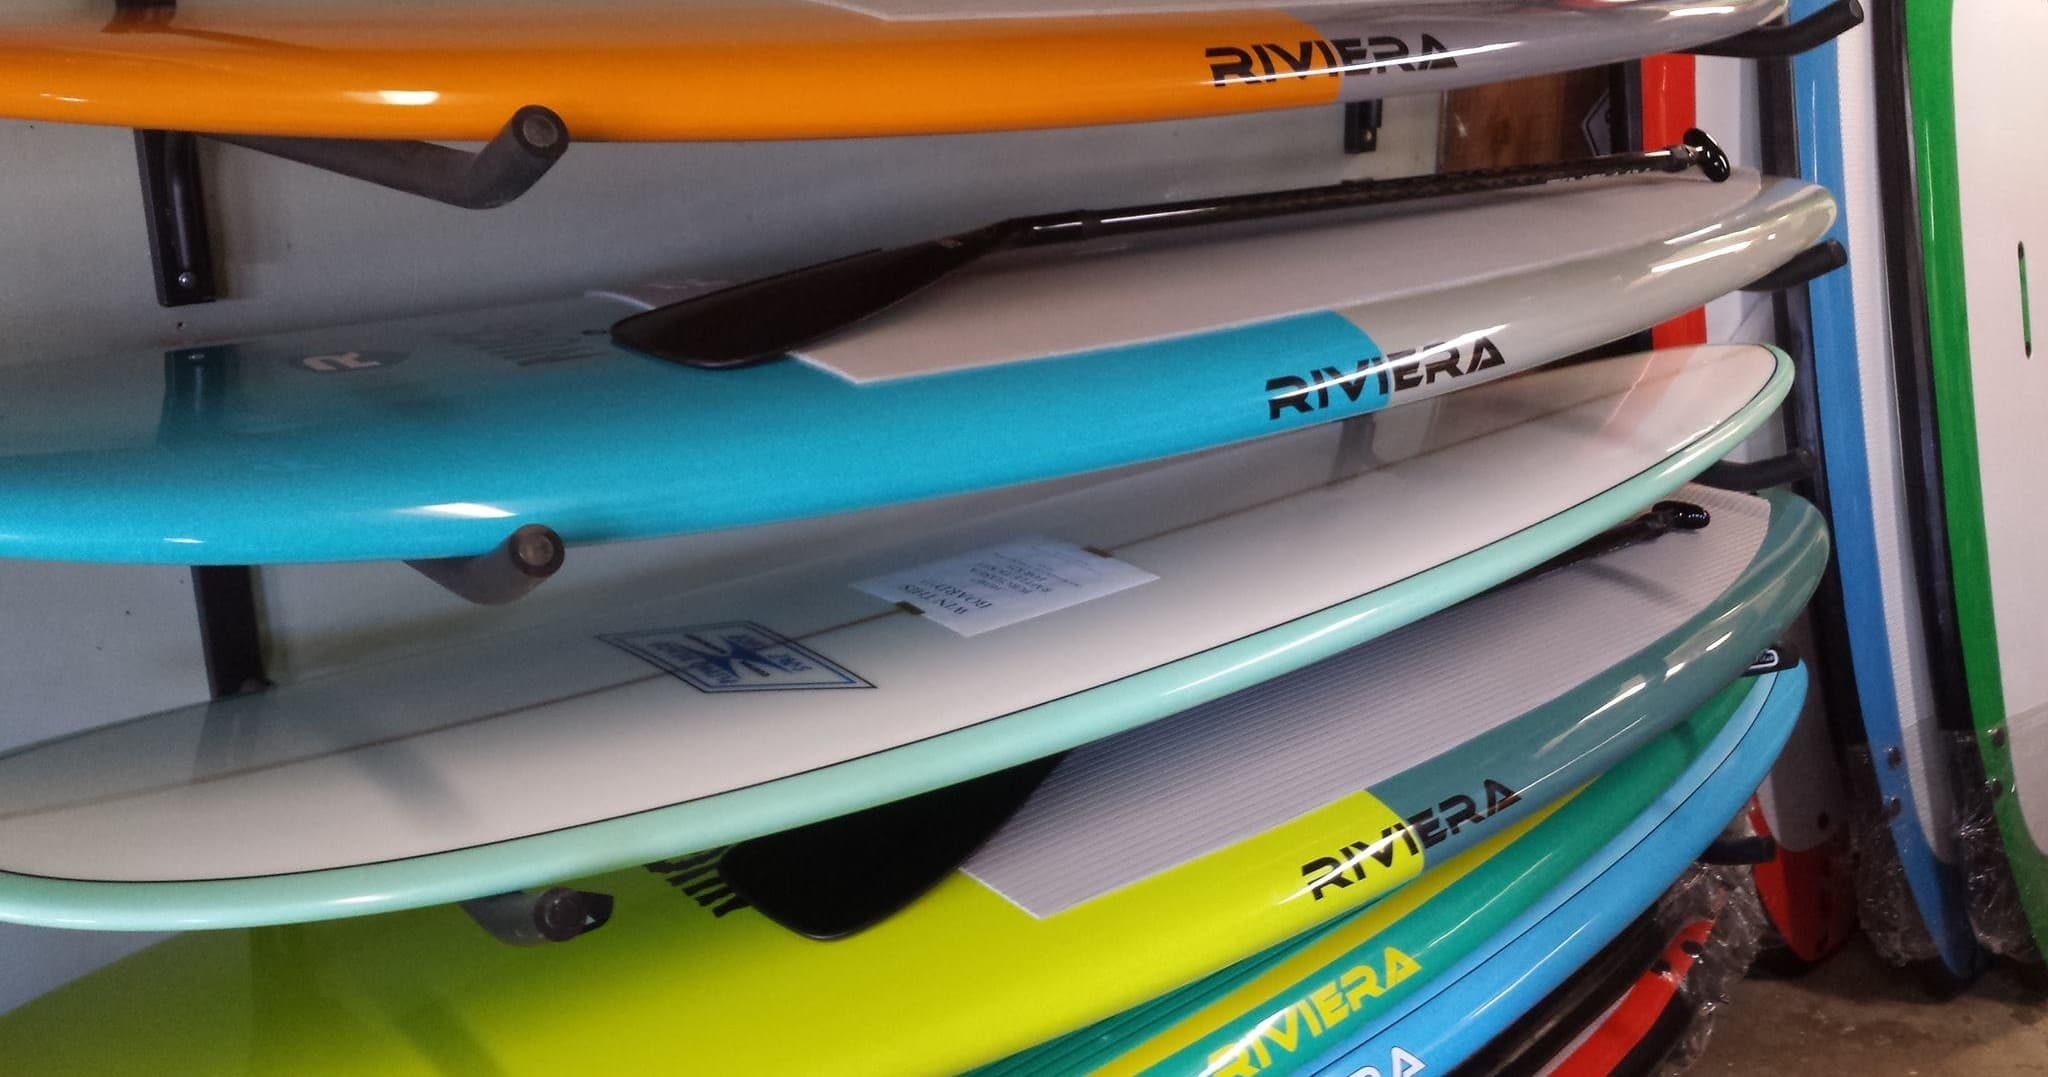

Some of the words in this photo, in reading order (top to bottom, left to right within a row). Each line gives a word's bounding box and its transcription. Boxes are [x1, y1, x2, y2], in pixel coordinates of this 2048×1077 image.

[1204, 33, 1459, 87] RIVIERA
[1265, 336, 1506, 421] RIVIERA
[1301, 779, 1522, 901] RIVIERA
[1207, 946, 1422, 1077] RIVIERA
